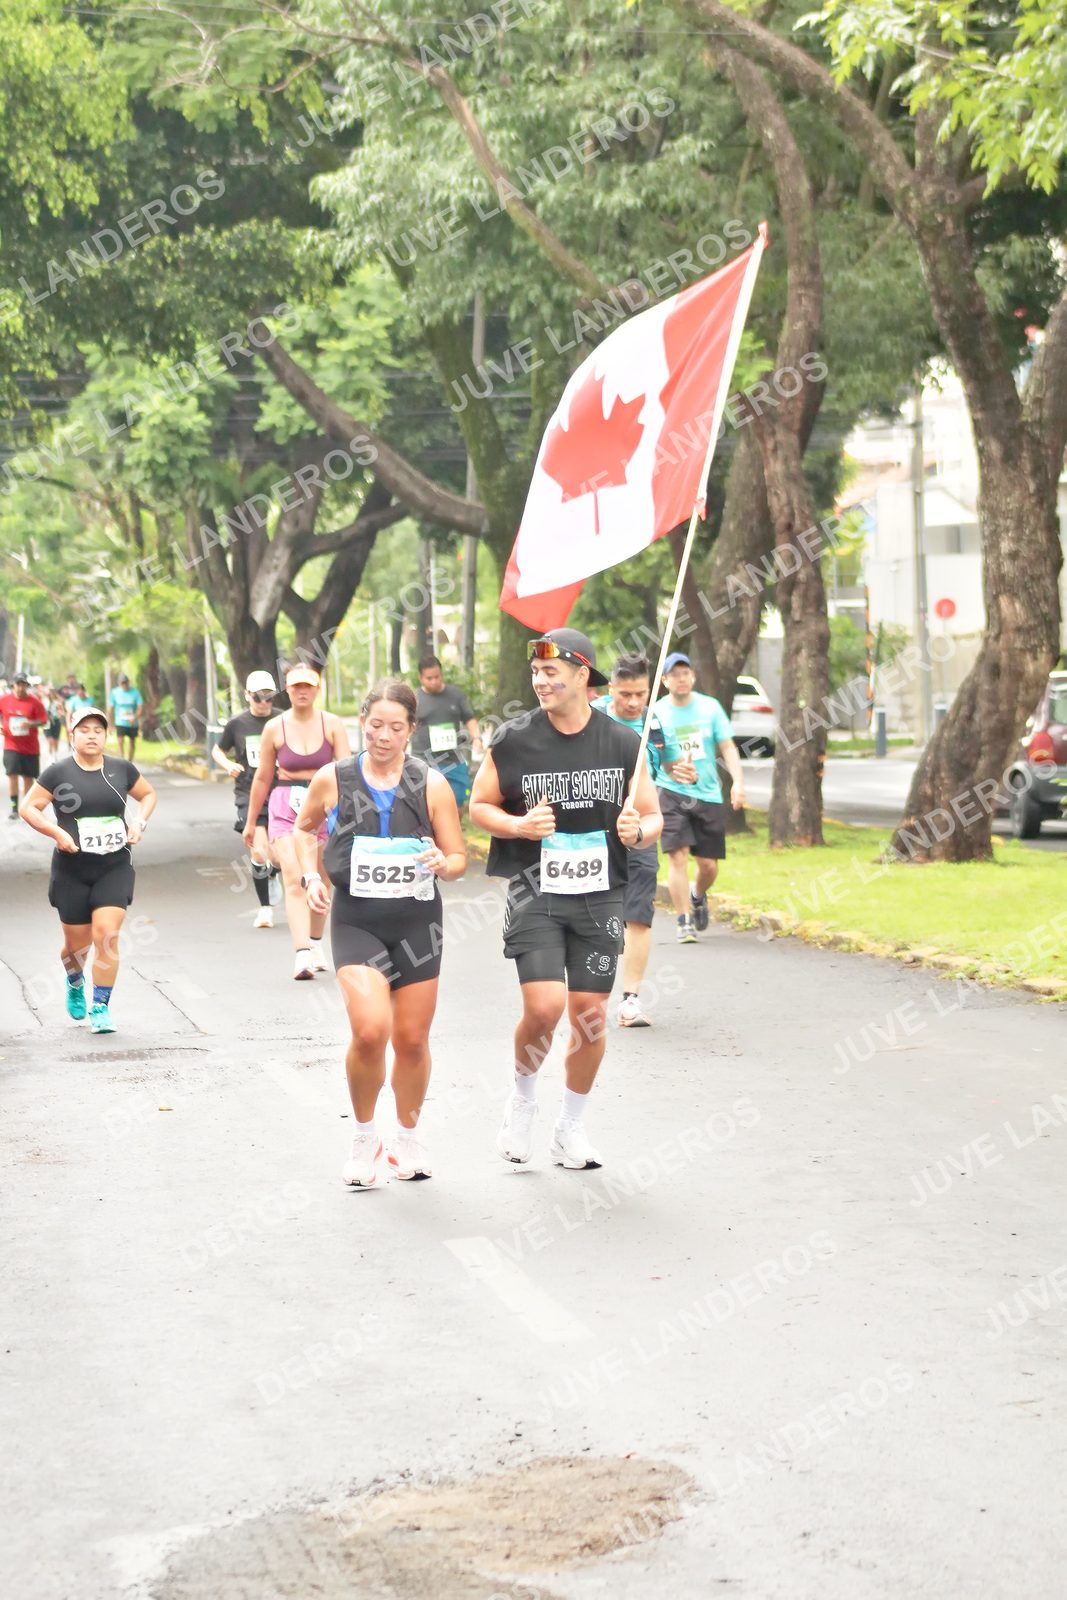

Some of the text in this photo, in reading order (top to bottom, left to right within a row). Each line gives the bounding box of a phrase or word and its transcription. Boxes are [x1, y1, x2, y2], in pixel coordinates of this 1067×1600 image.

[522, 768, 625, 812] SWEAT SOCIETY
[561, 800, 594, 810] TORONTO
[84, 832, 124, 848] 2125
[355, 864, 416, 884] 5625
[546, 858, 603, 879] 6489
